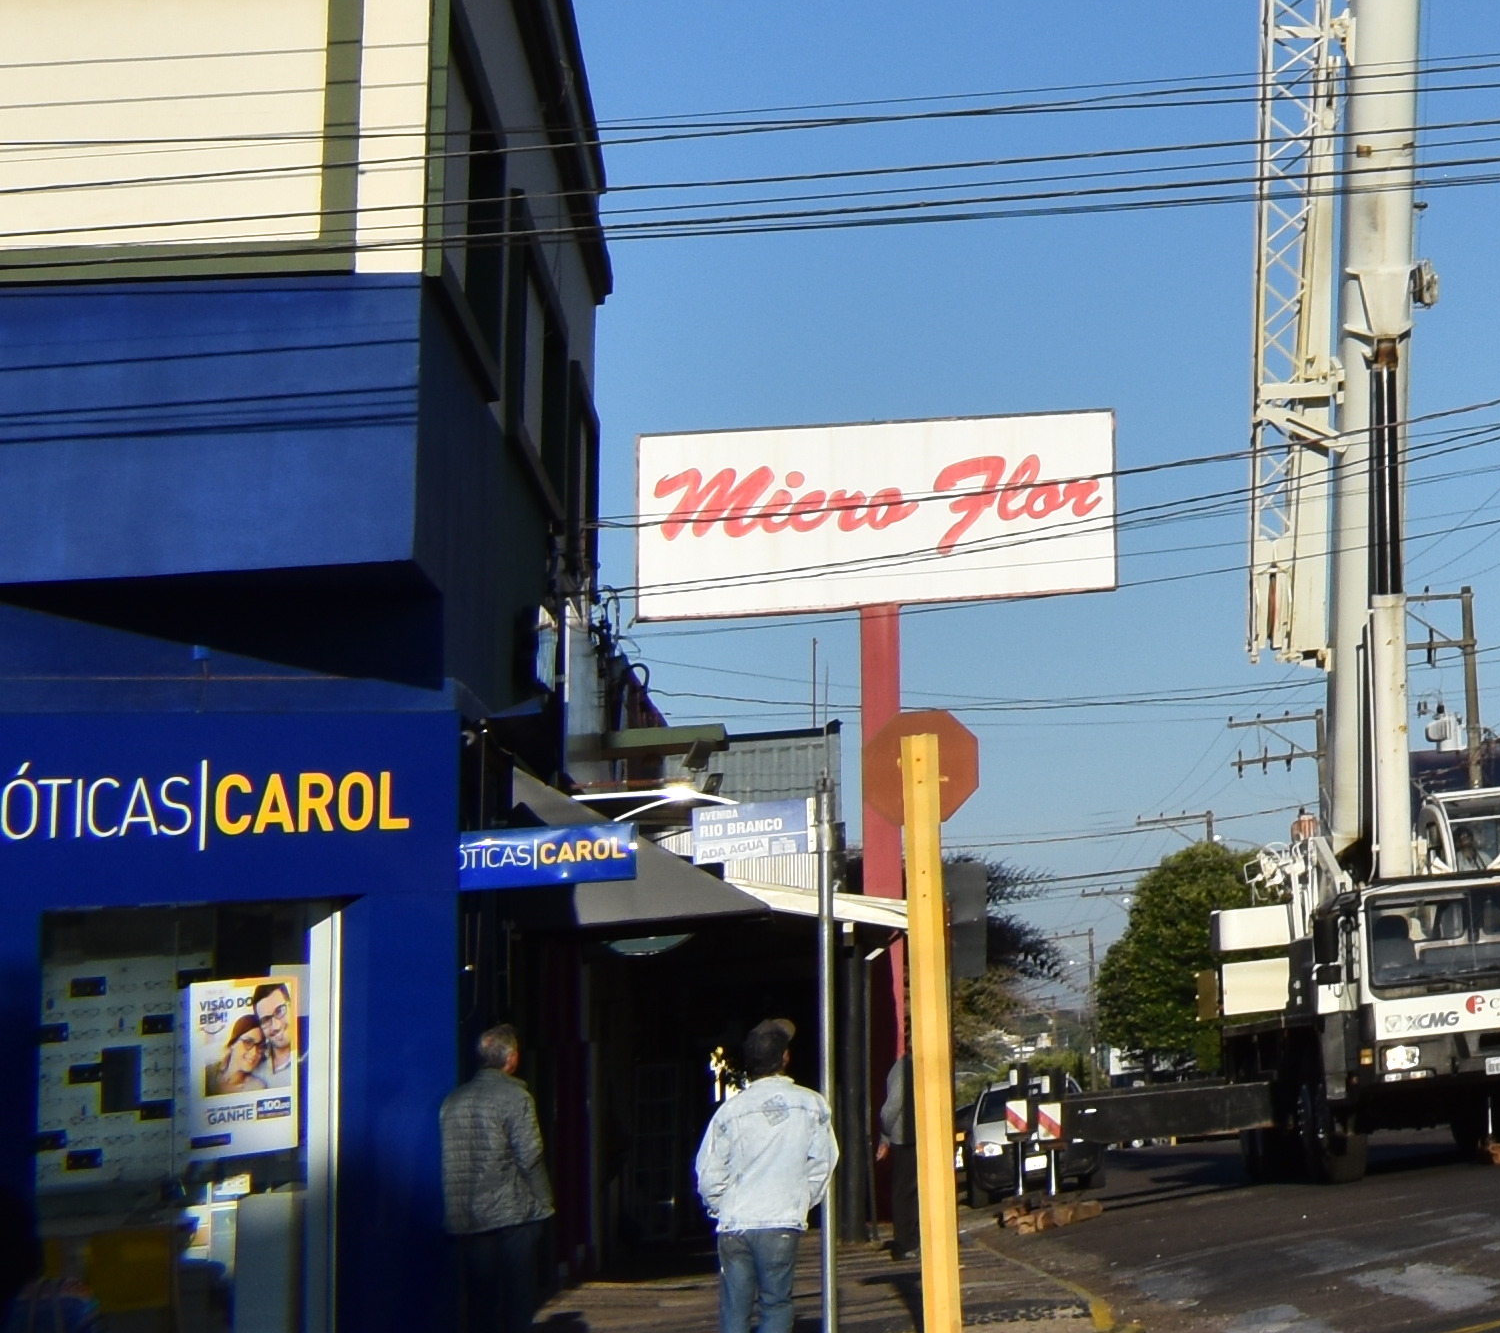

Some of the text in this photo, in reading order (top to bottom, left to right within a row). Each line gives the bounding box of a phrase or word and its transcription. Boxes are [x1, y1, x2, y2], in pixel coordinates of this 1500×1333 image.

[654, 452, 1105, 556] Micro Flor
[0, 761, 410, 843] ÓTICAS CAROL
[700, 808, 739, 822] AVENIDA
[700, 817, 783, 837] RIO BRANCO
[539, 836, 627, 866] CAROL
[199, 996, 254, 1012] VISÃO DO
[199, 1012, 228, 1026] BEM!
[1406, 1010, 1460, 1031] XCMG
[207, 1108, 254, 1126] GANHE
